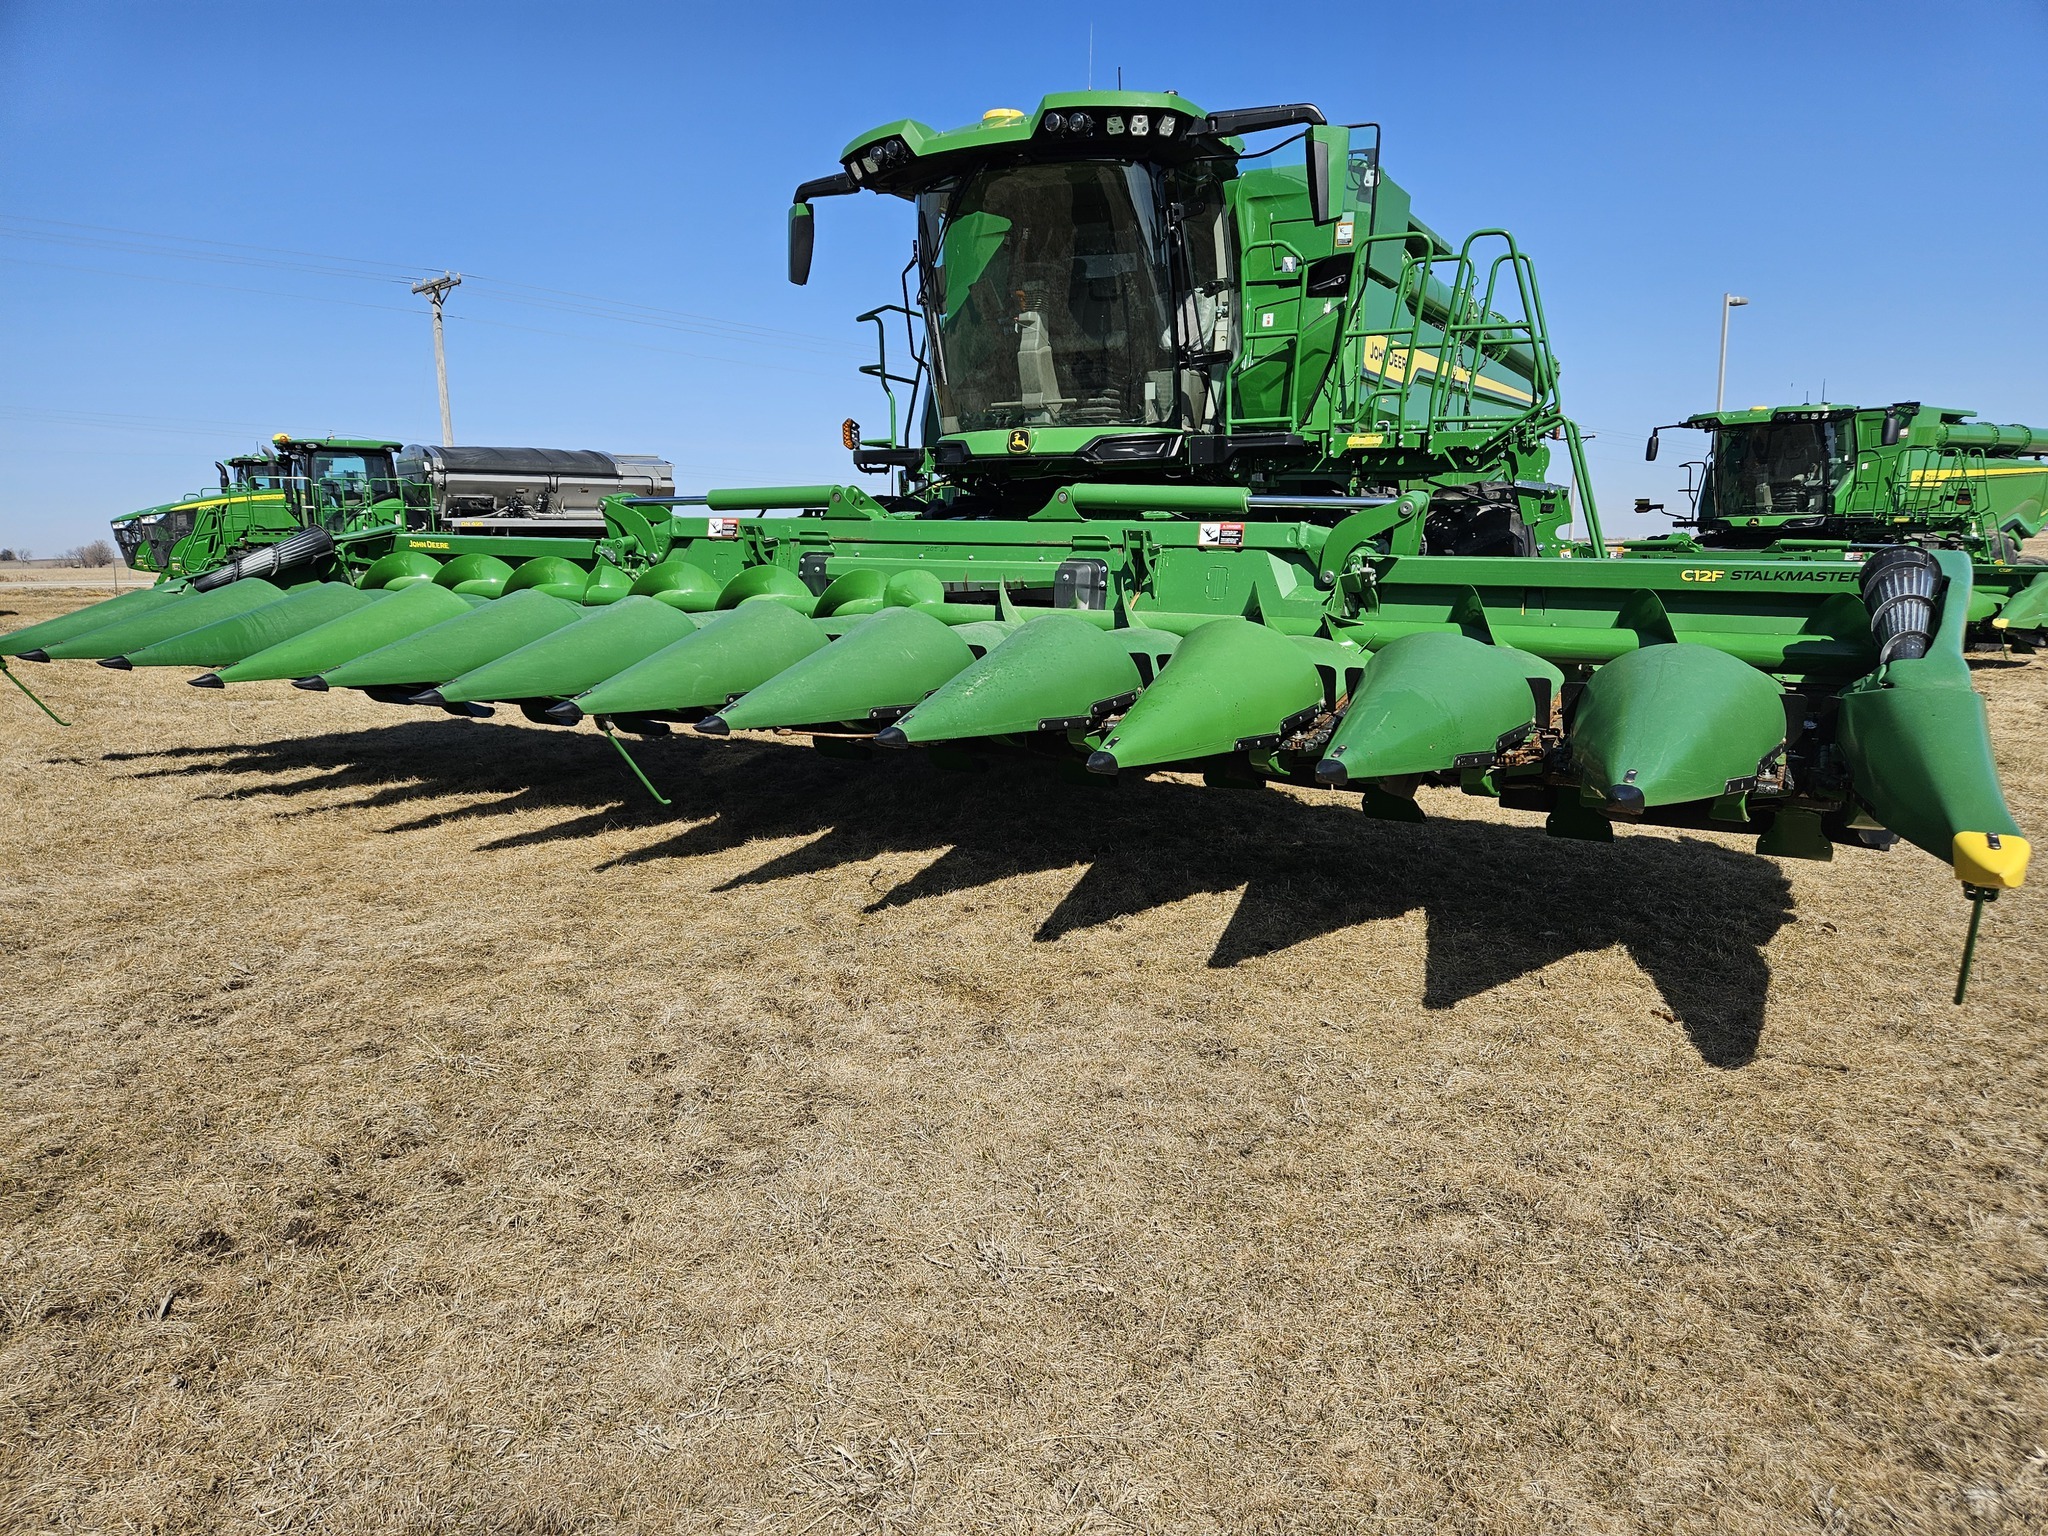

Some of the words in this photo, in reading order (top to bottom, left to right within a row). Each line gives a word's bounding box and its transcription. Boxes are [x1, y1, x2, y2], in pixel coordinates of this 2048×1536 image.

[1370, 341, 1386, 363] JOH
[1389, 350, 1409, 371] DEER
[409, 540, 427, 549] JOHN
[426, 540, 450, 550] DEERE
[1680, 569, 1726, 583] C12F
